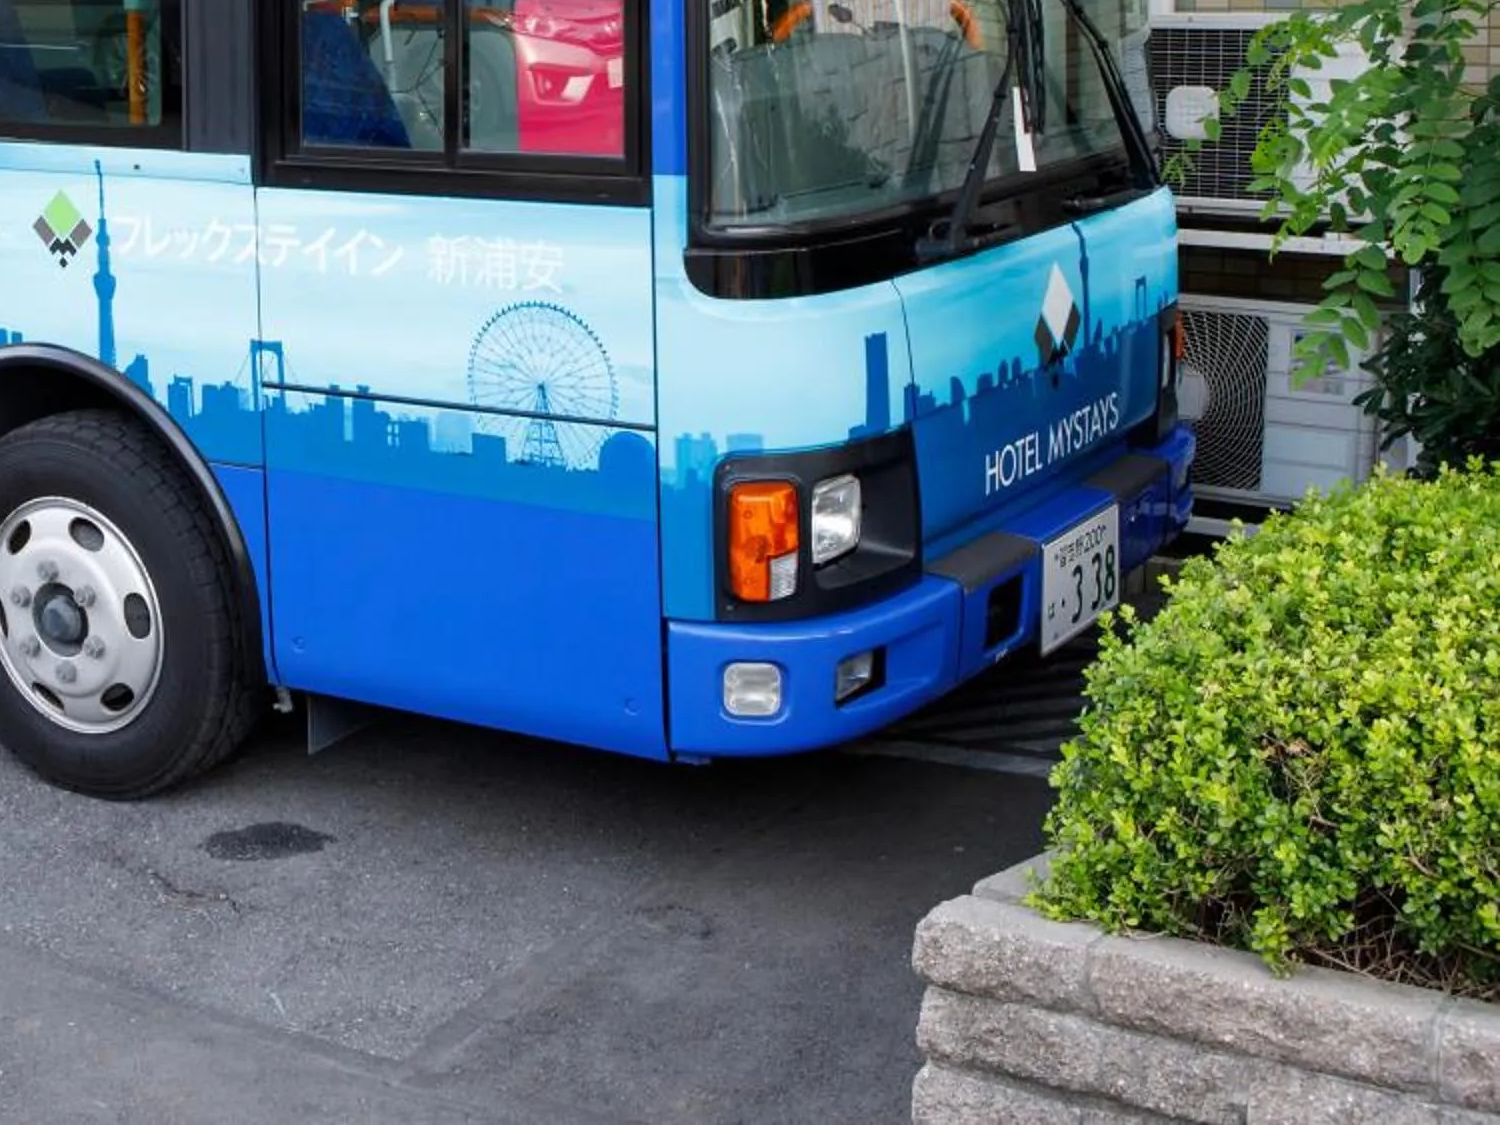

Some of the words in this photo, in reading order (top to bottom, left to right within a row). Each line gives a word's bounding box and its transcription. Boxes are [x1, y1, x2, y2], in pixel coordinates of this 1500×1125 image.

[111, 215, 404, 276] フレックステイイン
[429, 232, 565, 293] 新浦安
[985, 431, 1043, 496] HOTEL
[1047, 392, 1119, 465] MYSTAYS
